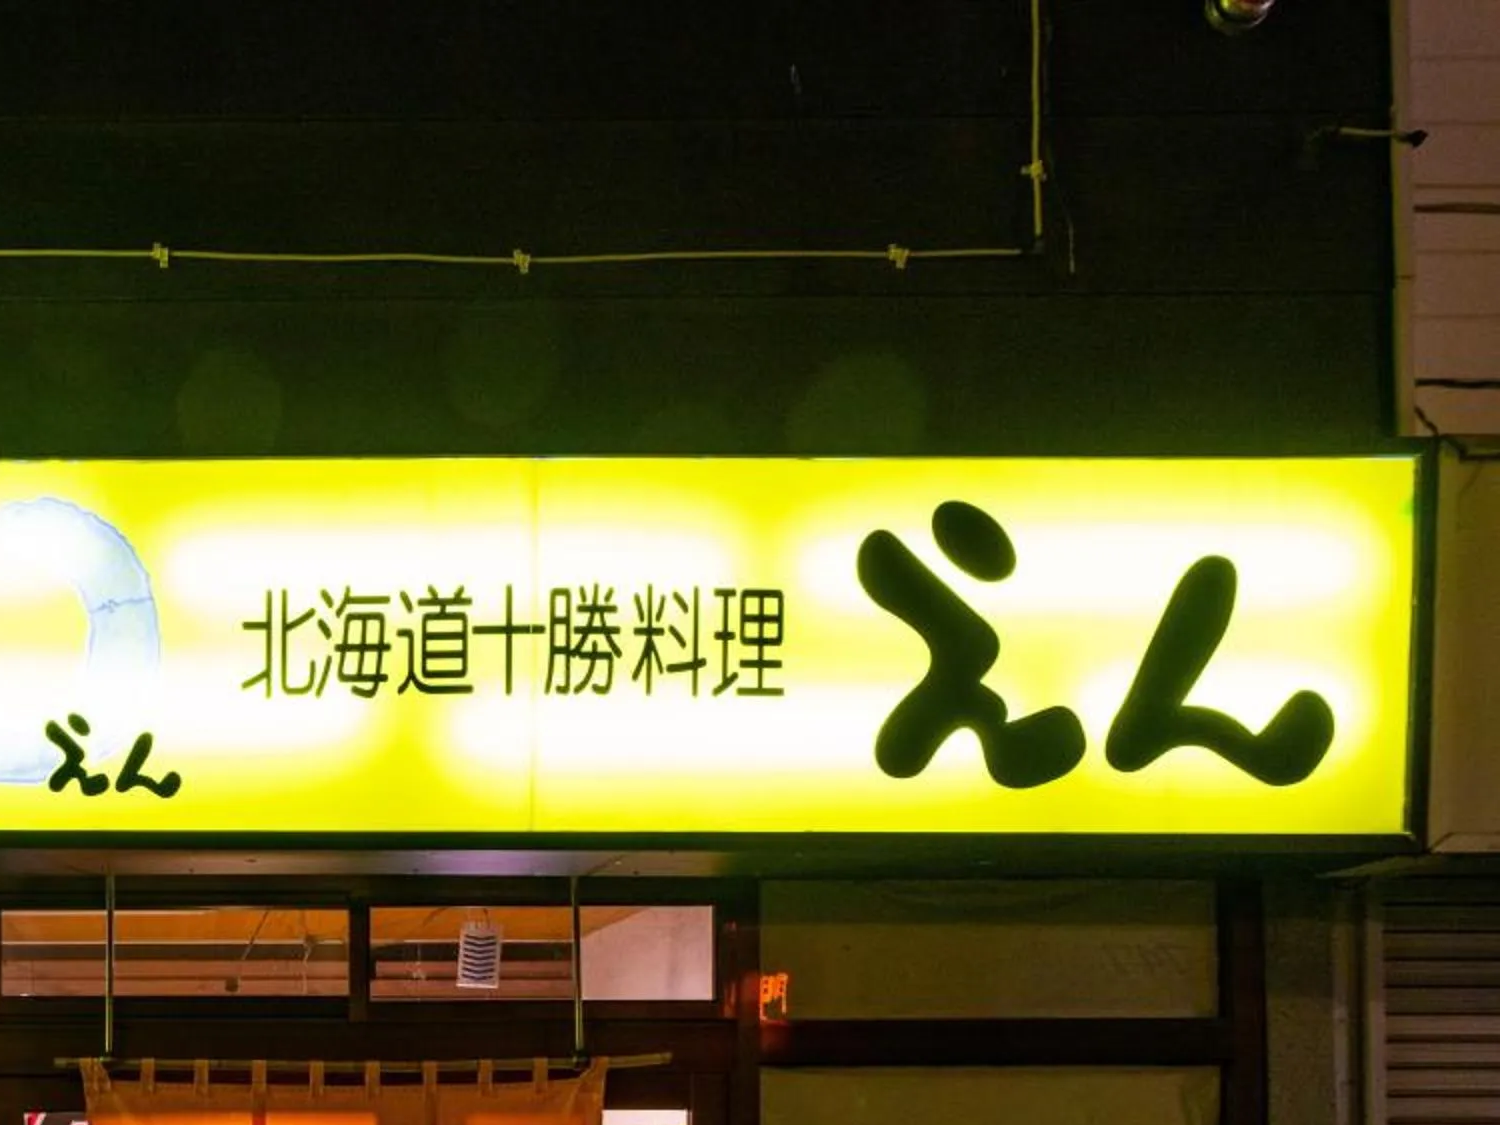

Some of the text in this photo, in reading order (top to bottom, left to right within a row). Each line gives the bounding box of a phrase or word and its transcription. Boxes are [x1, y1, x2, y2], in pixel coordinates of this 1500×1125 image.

[240, 583, 786, 700] 北海道十勝料理
[856, 499, 1335, 790] えん
[45, 713, 182, 798] えん
